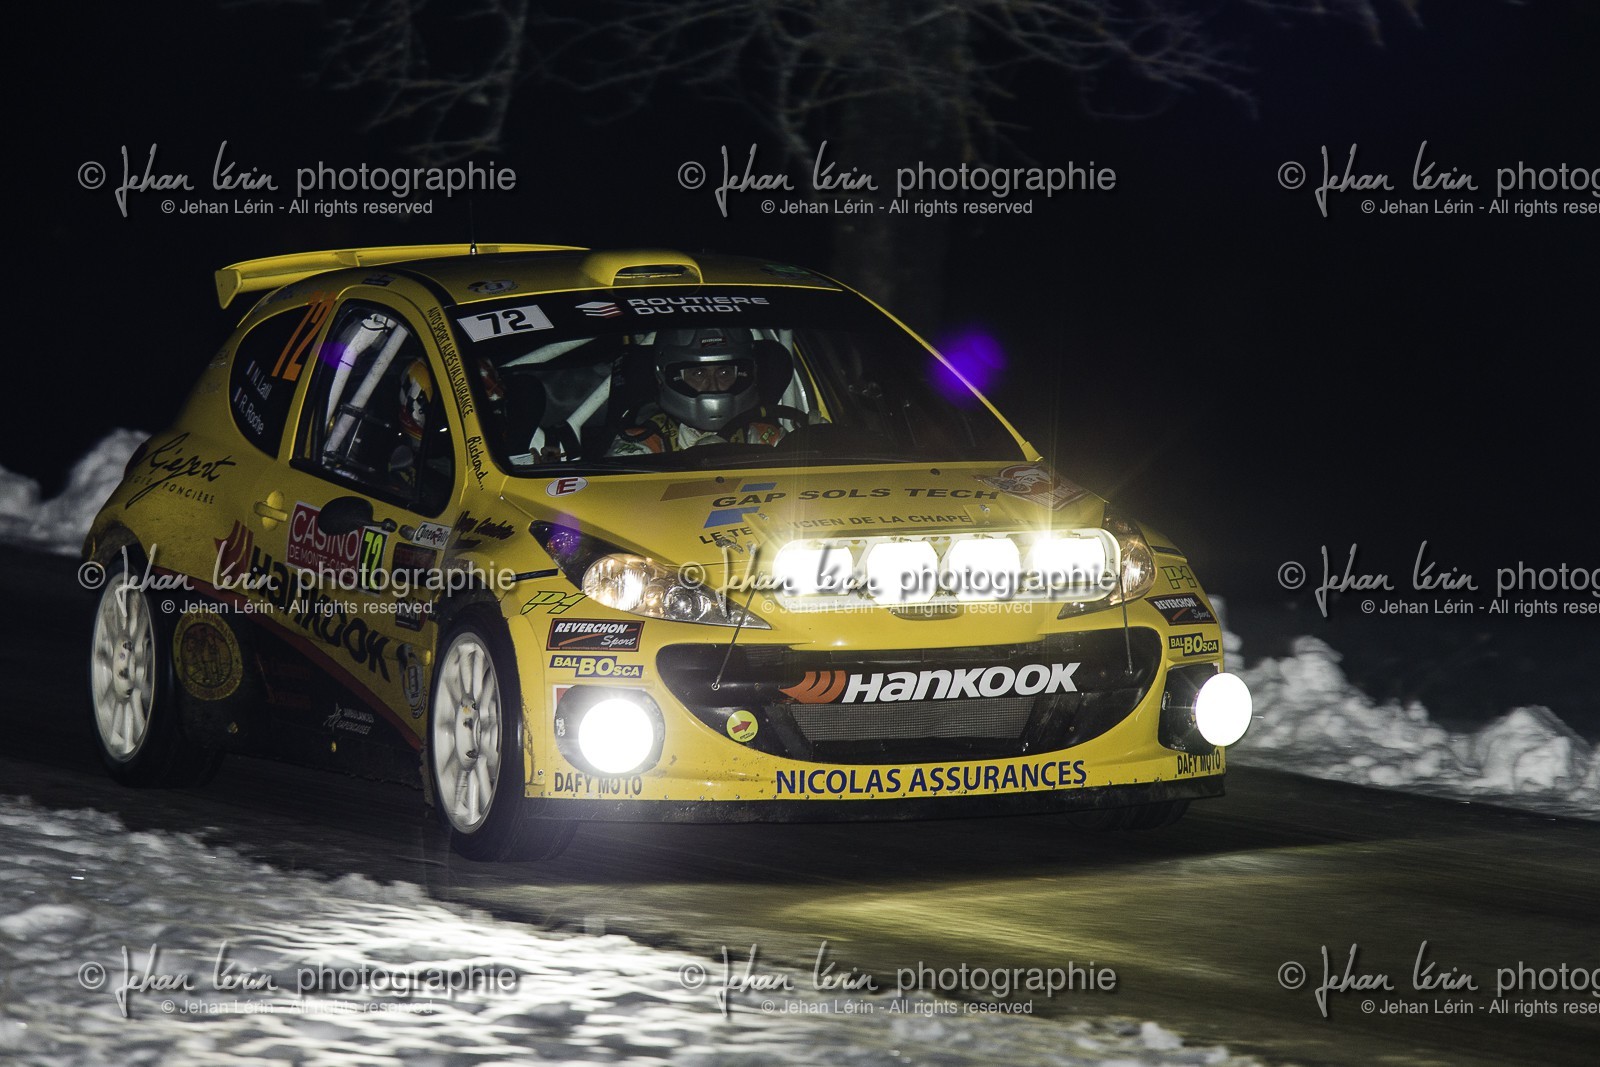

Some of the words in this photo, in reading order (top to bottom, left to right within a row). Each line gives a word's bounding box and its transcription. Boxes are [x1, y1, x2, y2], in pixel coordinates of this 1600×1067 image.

[627, 296, 770, 306] ROUTIERE
[634, 305, 675, 315] DU
[681, 304, 742, 314] MIDI
[428, 306, 442, 326] AUTO
[476, 309, 534, 334] 72
[271, 291, 337, 381] 72
[433, 321, 450, 346] SPORT
[441, 342, 459, 367] ALPES
[450, 362, 463, 382] VAL
[454, 376, 474, 419] DURANCE
[245, 403, 265, 435] Roche
[712, 492, 786, 508] GAP
[798, 487, 896, 500] SOLS
[903, 486, 1000, 500] TECH
[848, 516, 873, 525] DE
[878, 515, 901, 524] LA
[364, 531, 384, 590] 72
[1153, 597, 1197, 610] REVERCHON
[555, 622, 629, 634] REVERCHON
[600, 634, 636, 648] Sport
[1176, 754, 1198, 775] DAFY
[1200, 749, 1221, 775] MOTO
[554, 772, 593, 793] DAFY
[599, 775, 643, 796] MOTO
[776, 769, 901, 794] NICOLAS
[908, 759, 1088, 793] ASSURANCES
